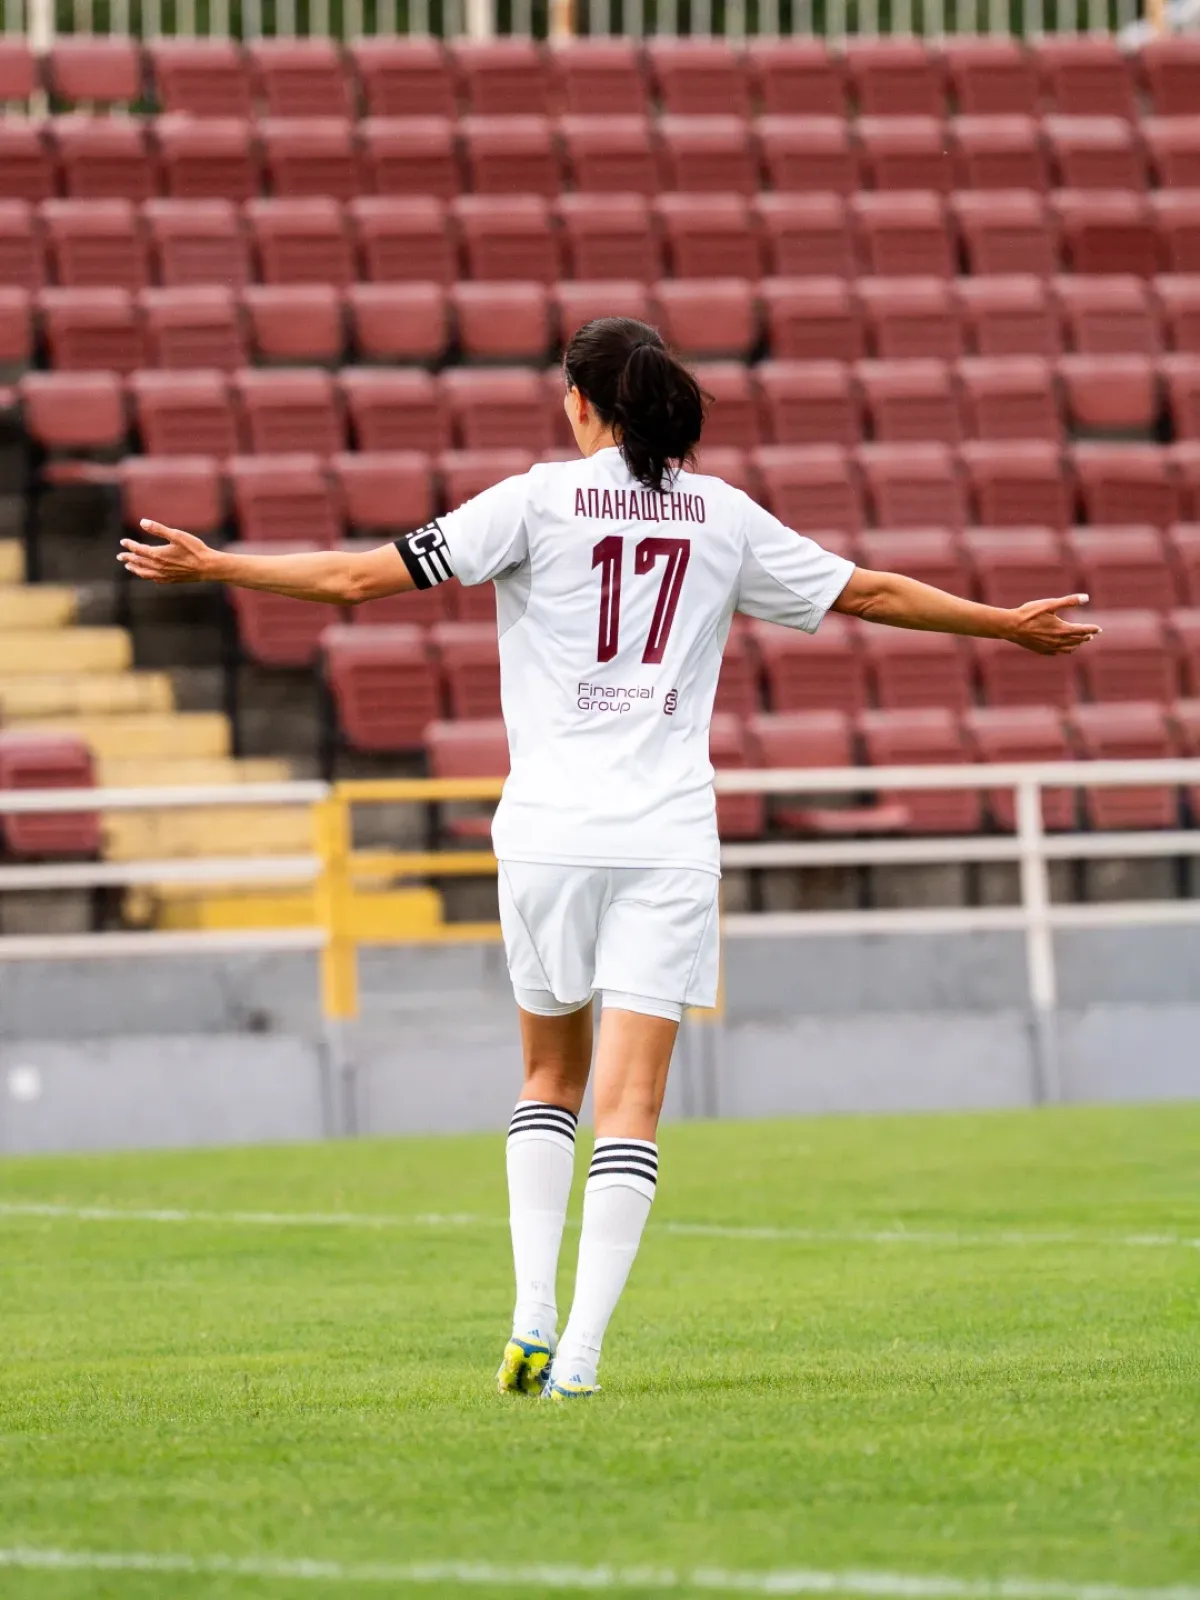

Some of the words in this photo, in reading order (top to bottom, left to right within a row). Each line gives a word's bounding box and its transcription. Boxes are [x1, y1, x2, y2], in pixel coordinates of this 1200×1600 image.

[574, 487, 706, 524] АПАНАЩЕНКО
[591, 535, 691, 664] 17
[577, 682, 655, 699] Financial
[577, 697, 631, 714] Group
